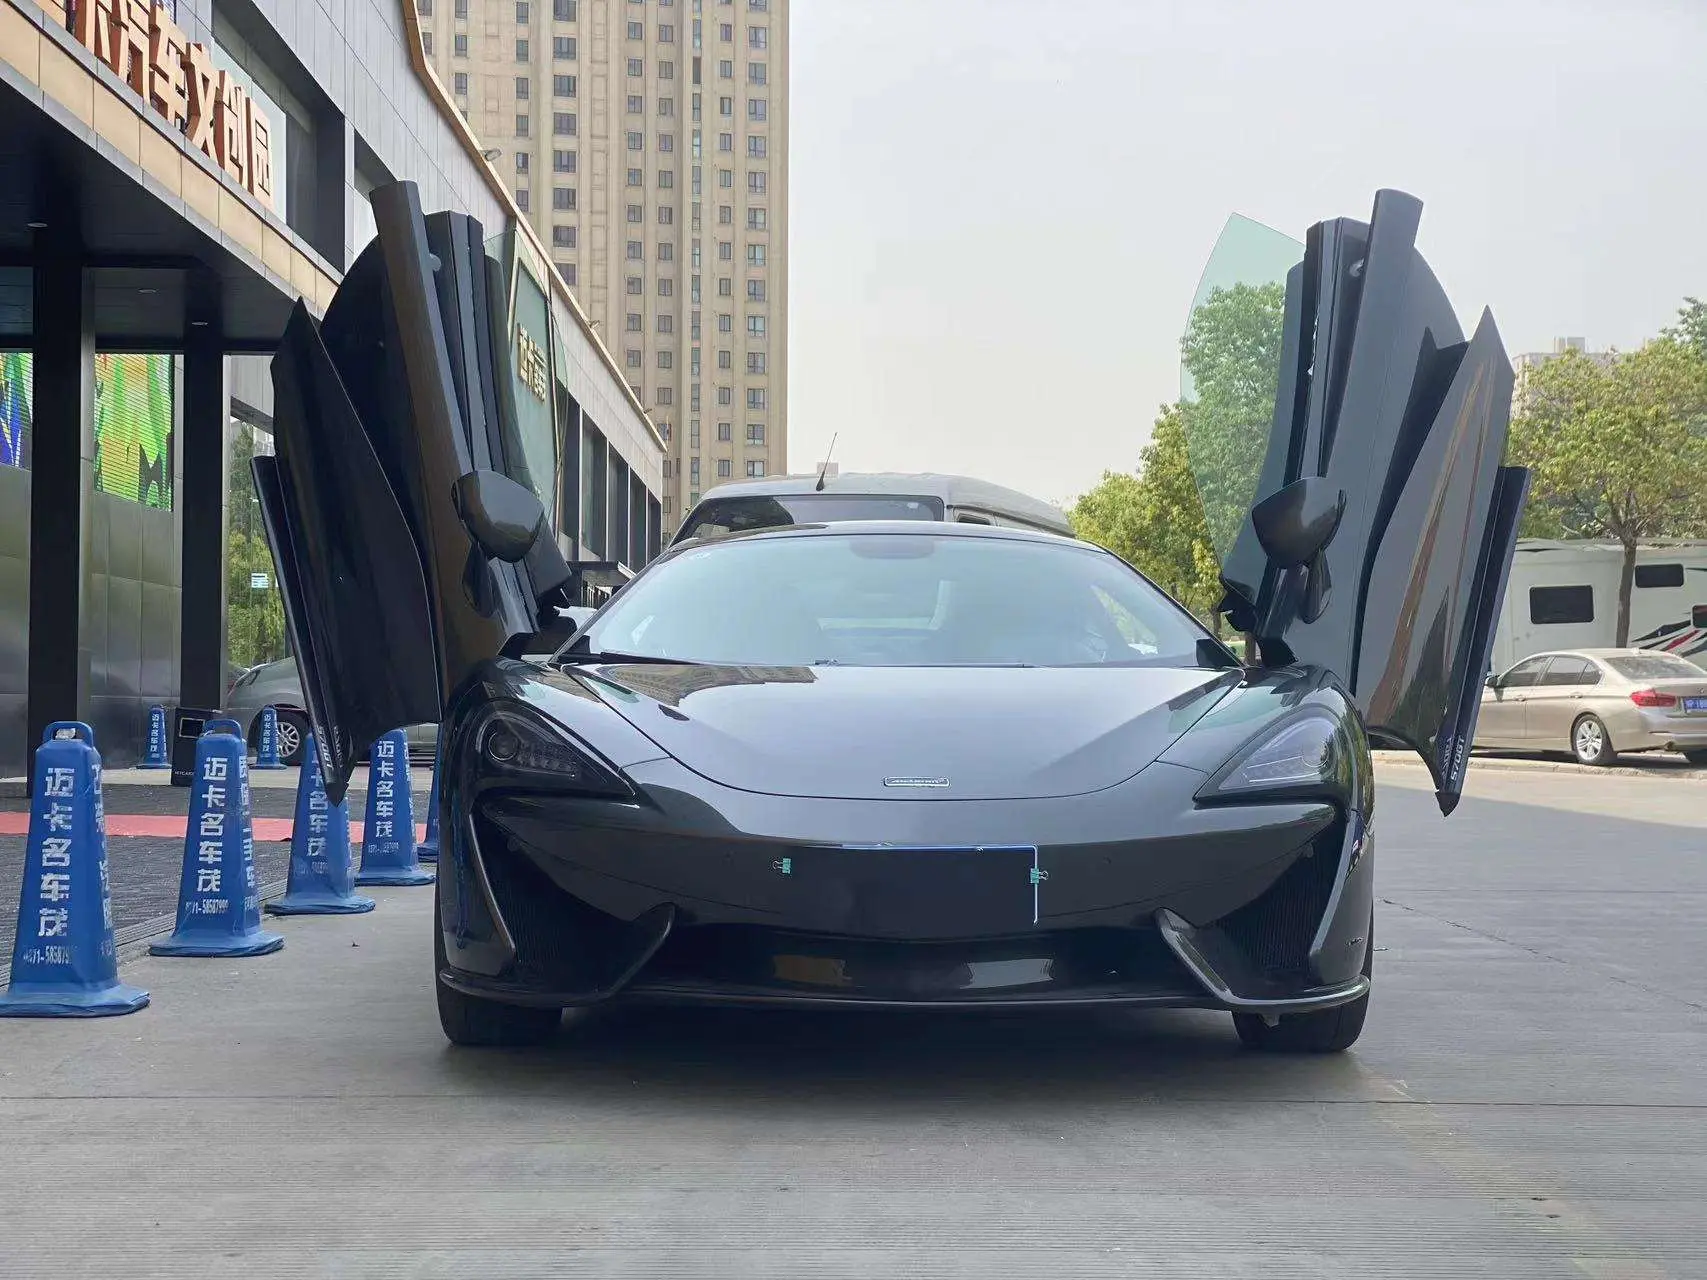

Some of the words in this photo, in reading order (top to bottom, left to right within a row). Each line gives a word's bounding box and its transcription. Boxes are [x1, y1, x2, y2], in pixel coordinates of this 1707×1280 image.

[306, 751, 329, 857] 卡名车茂
[375, 740, 395, 838] 迈卡名车茂
[1450, 735, 1465, 781] 570GT
[38, 767, 75, 937] 迈卡名车茂
[197, 757, 228, 892] 迈卡名车茂
